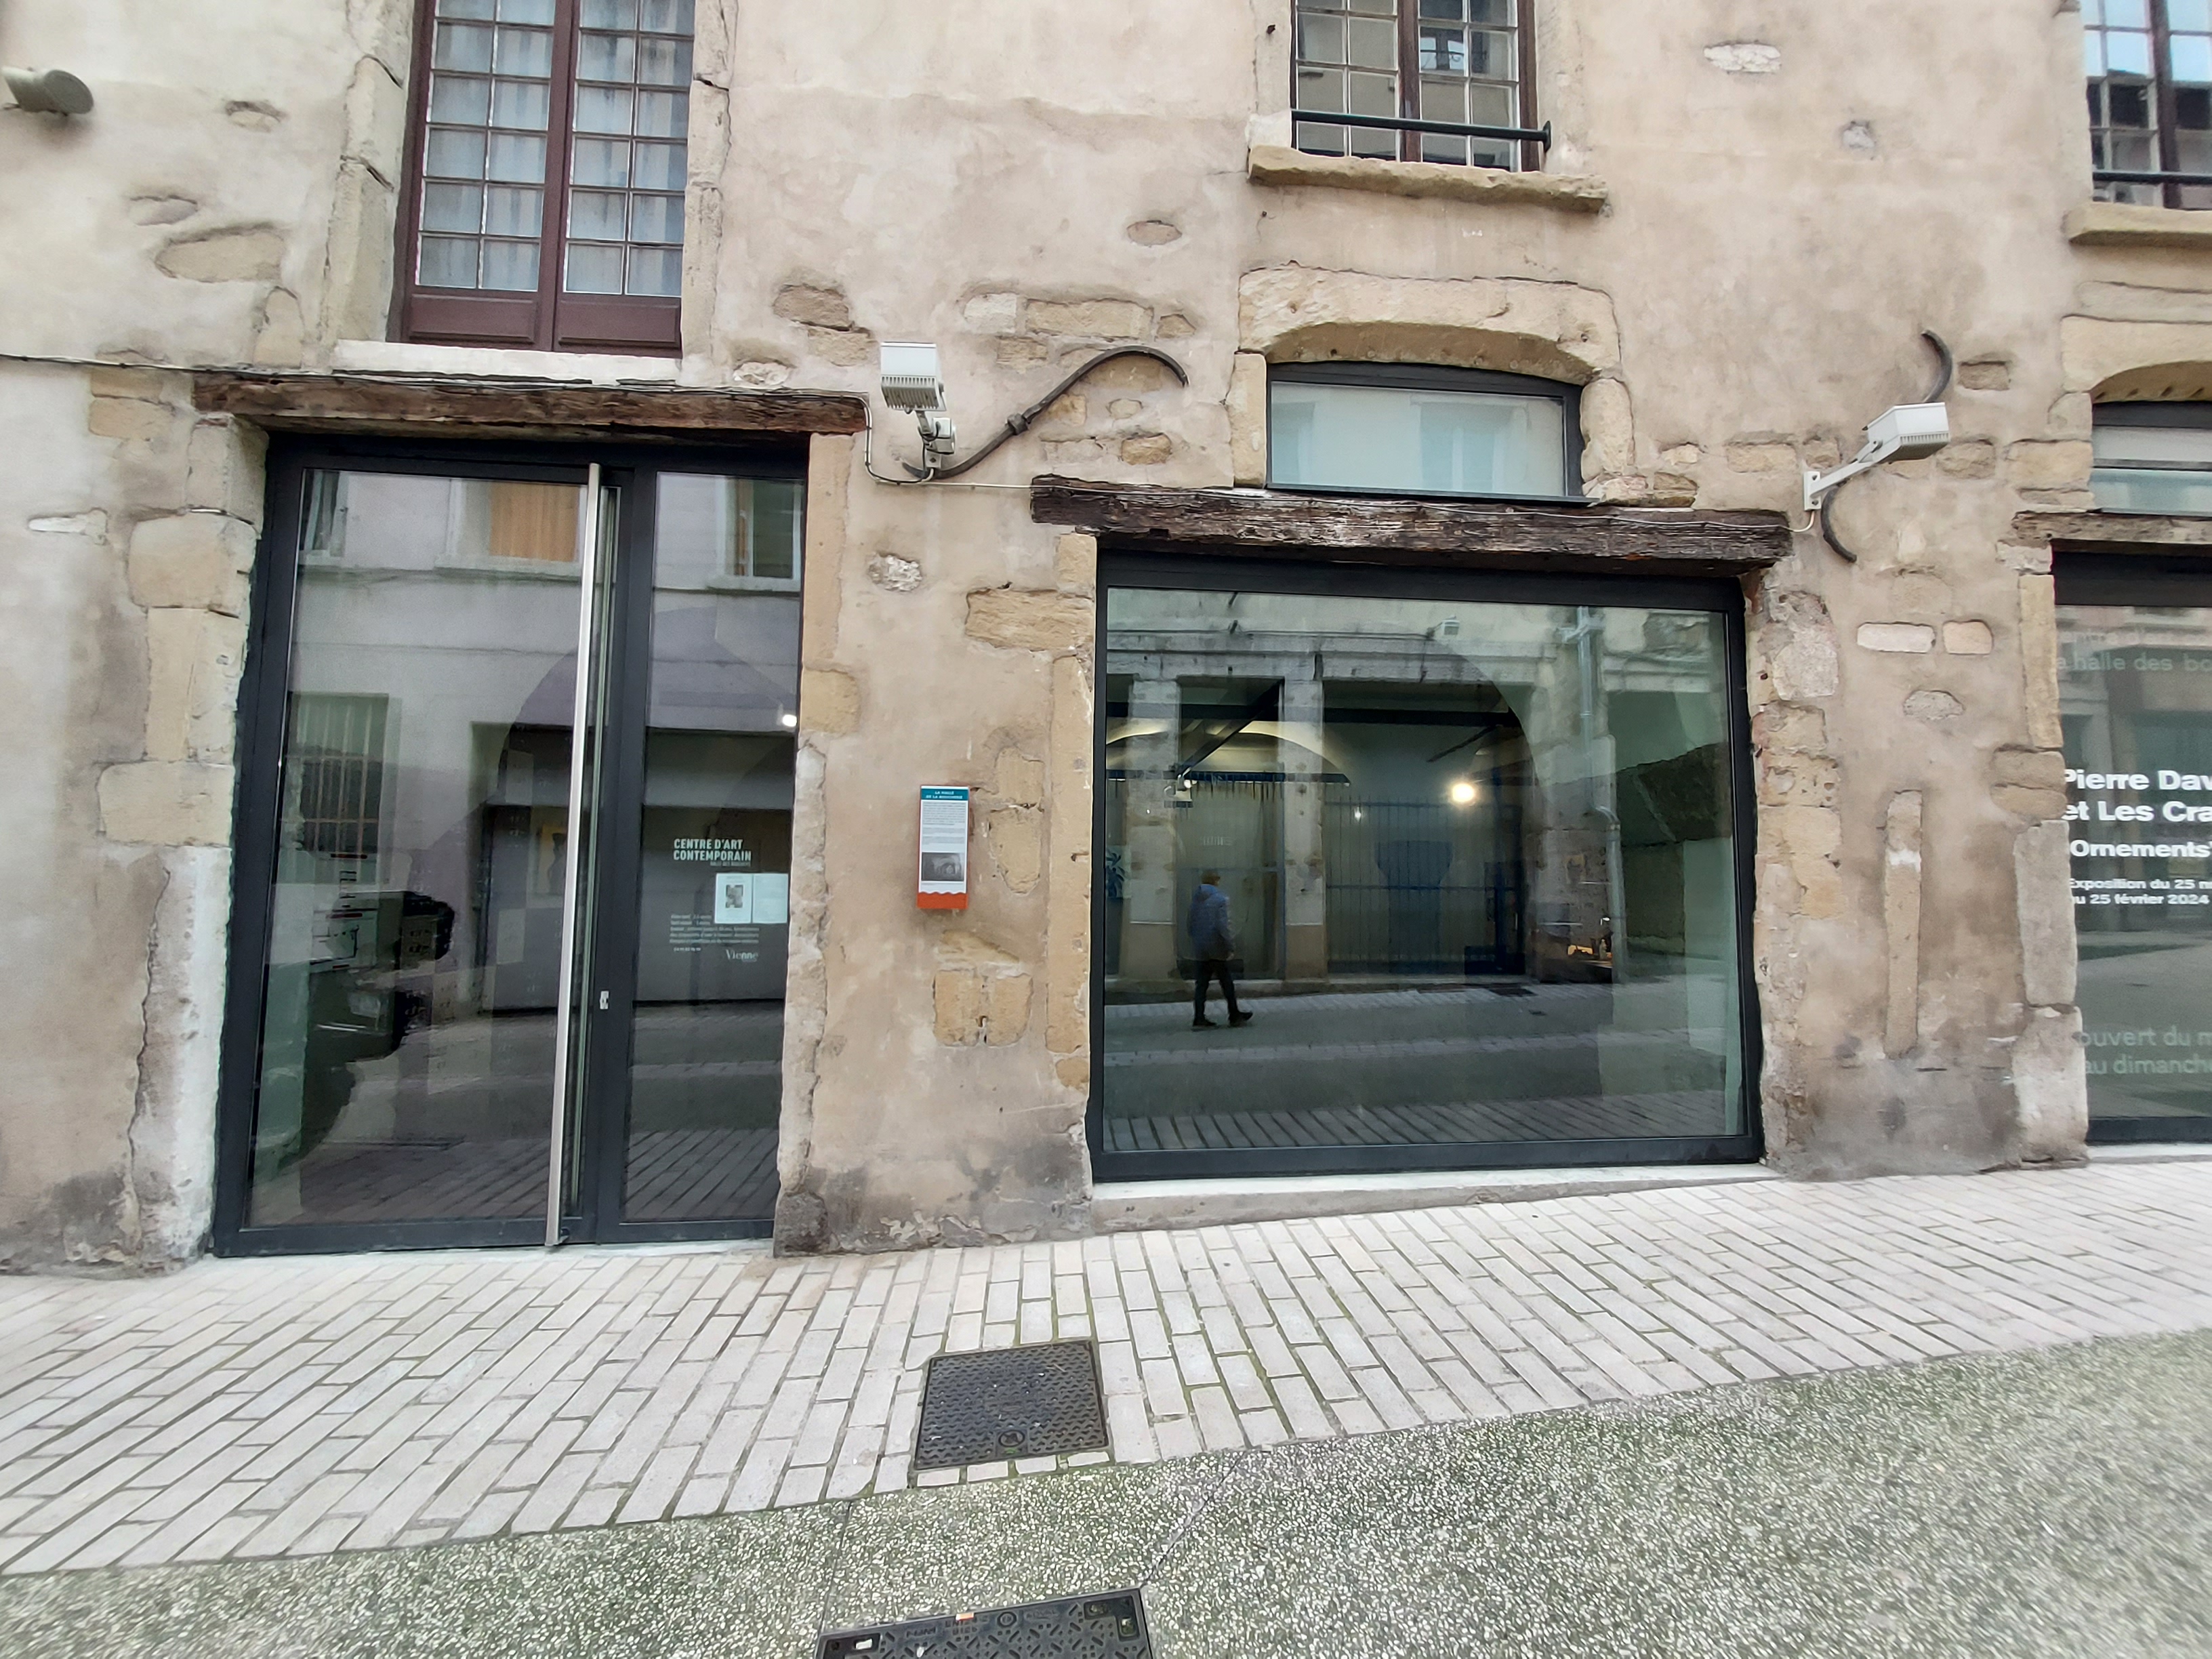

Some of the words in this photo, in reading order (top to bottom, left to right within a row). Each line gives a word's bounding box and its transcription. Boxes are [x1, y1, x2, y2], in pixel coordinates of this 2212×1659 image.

[2073, 650, 2126, 670] halle
[2135, 651, 2173, 672] des
[2064, 769, 2150, 790] Pierre
[2062, 801, 2090, 821] et
[2097, 800, 2154, 821] Les
[2163, 800, 2212, 822] Cra
[674, 838, 712, 849] CENTRE
[714, 839, 743, 850] D'ART
[673, 849, 752, 861] CONTEMPORAIN
[2070, 878, 2146, 890] Exposition
[2150, 879, 2170, 889] du
[2174, 879, 2196, 889] 25
[2073, 895, 2086, 904] u
[2089, 894, 2111, 904] 25
[2114, 893, 2164, 904] février
[2167, 894, 2210, 905] 2024
[2163, 1025, 2190, 1046] du
